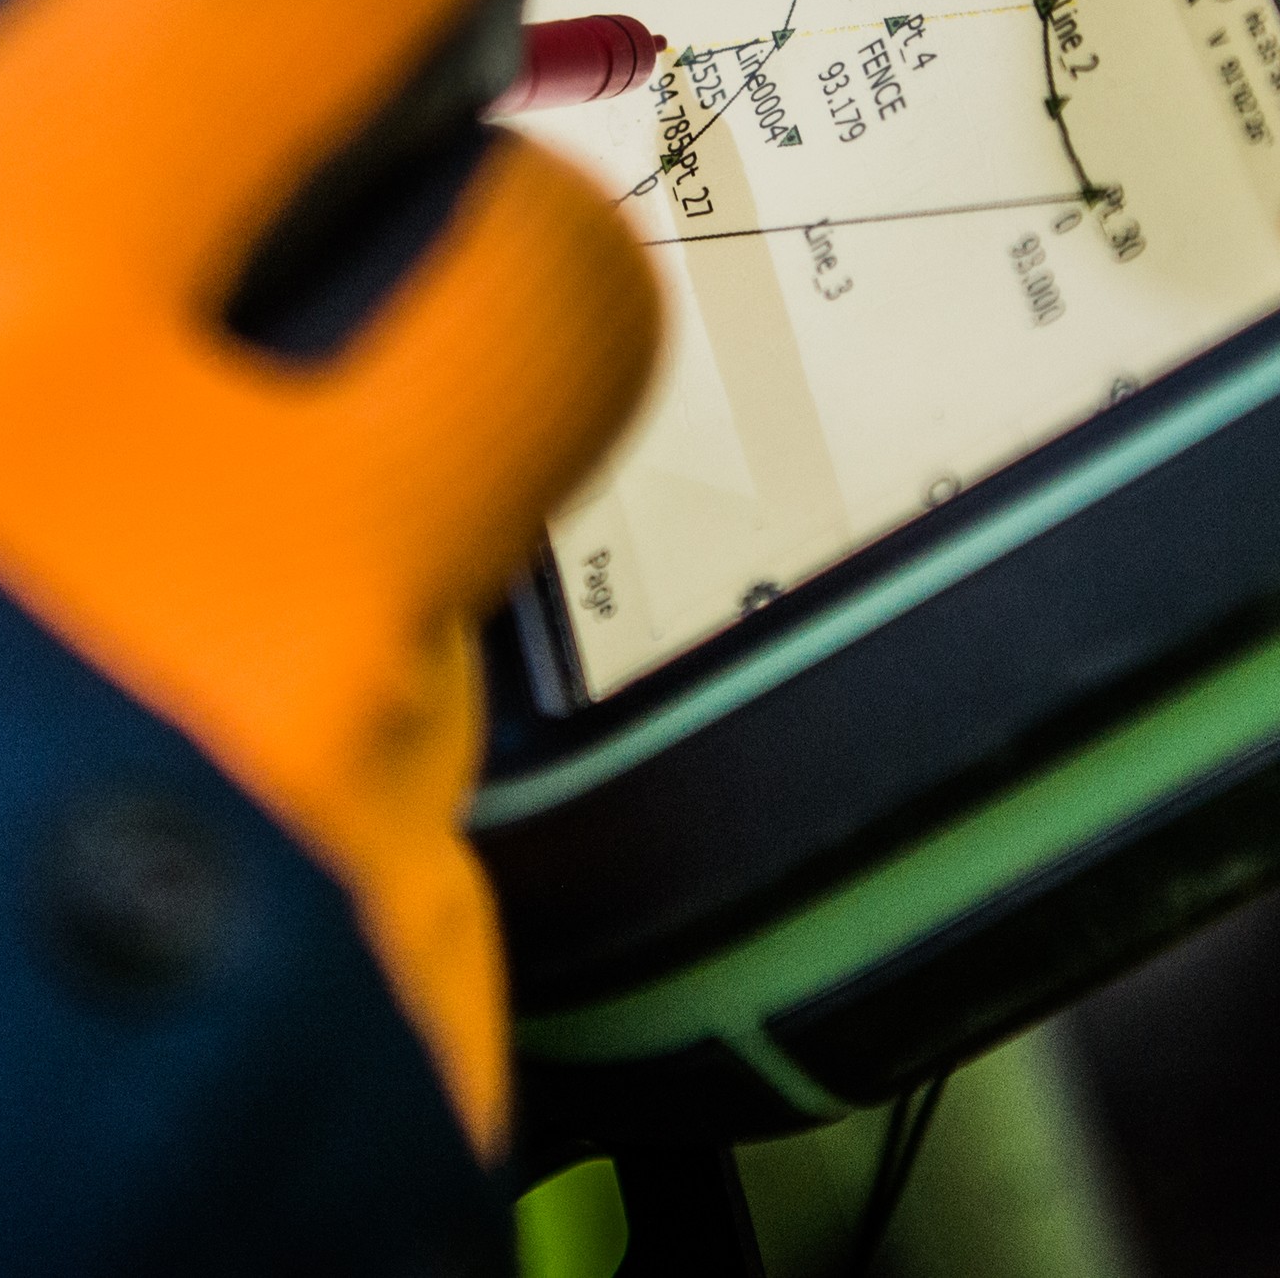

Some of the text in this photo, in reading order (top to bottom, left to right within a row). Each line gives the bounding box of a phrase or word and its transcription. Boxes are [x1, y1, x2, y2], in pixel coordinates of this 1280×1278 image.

[687, 49, 727, 110] 2525
[858, 38, 907, 121] FENCE
[897, 13, 938, 72] Pt_4
[649, 72, 695, 153] 94.785
[735, 39, 790, 144] Line0004
[818, 61, 867, 143] 93.179
[673, 150, 713, 218] Pt_27
[803, 217, 853, 300] Line_3
[581, 548, 617, 622] Page
